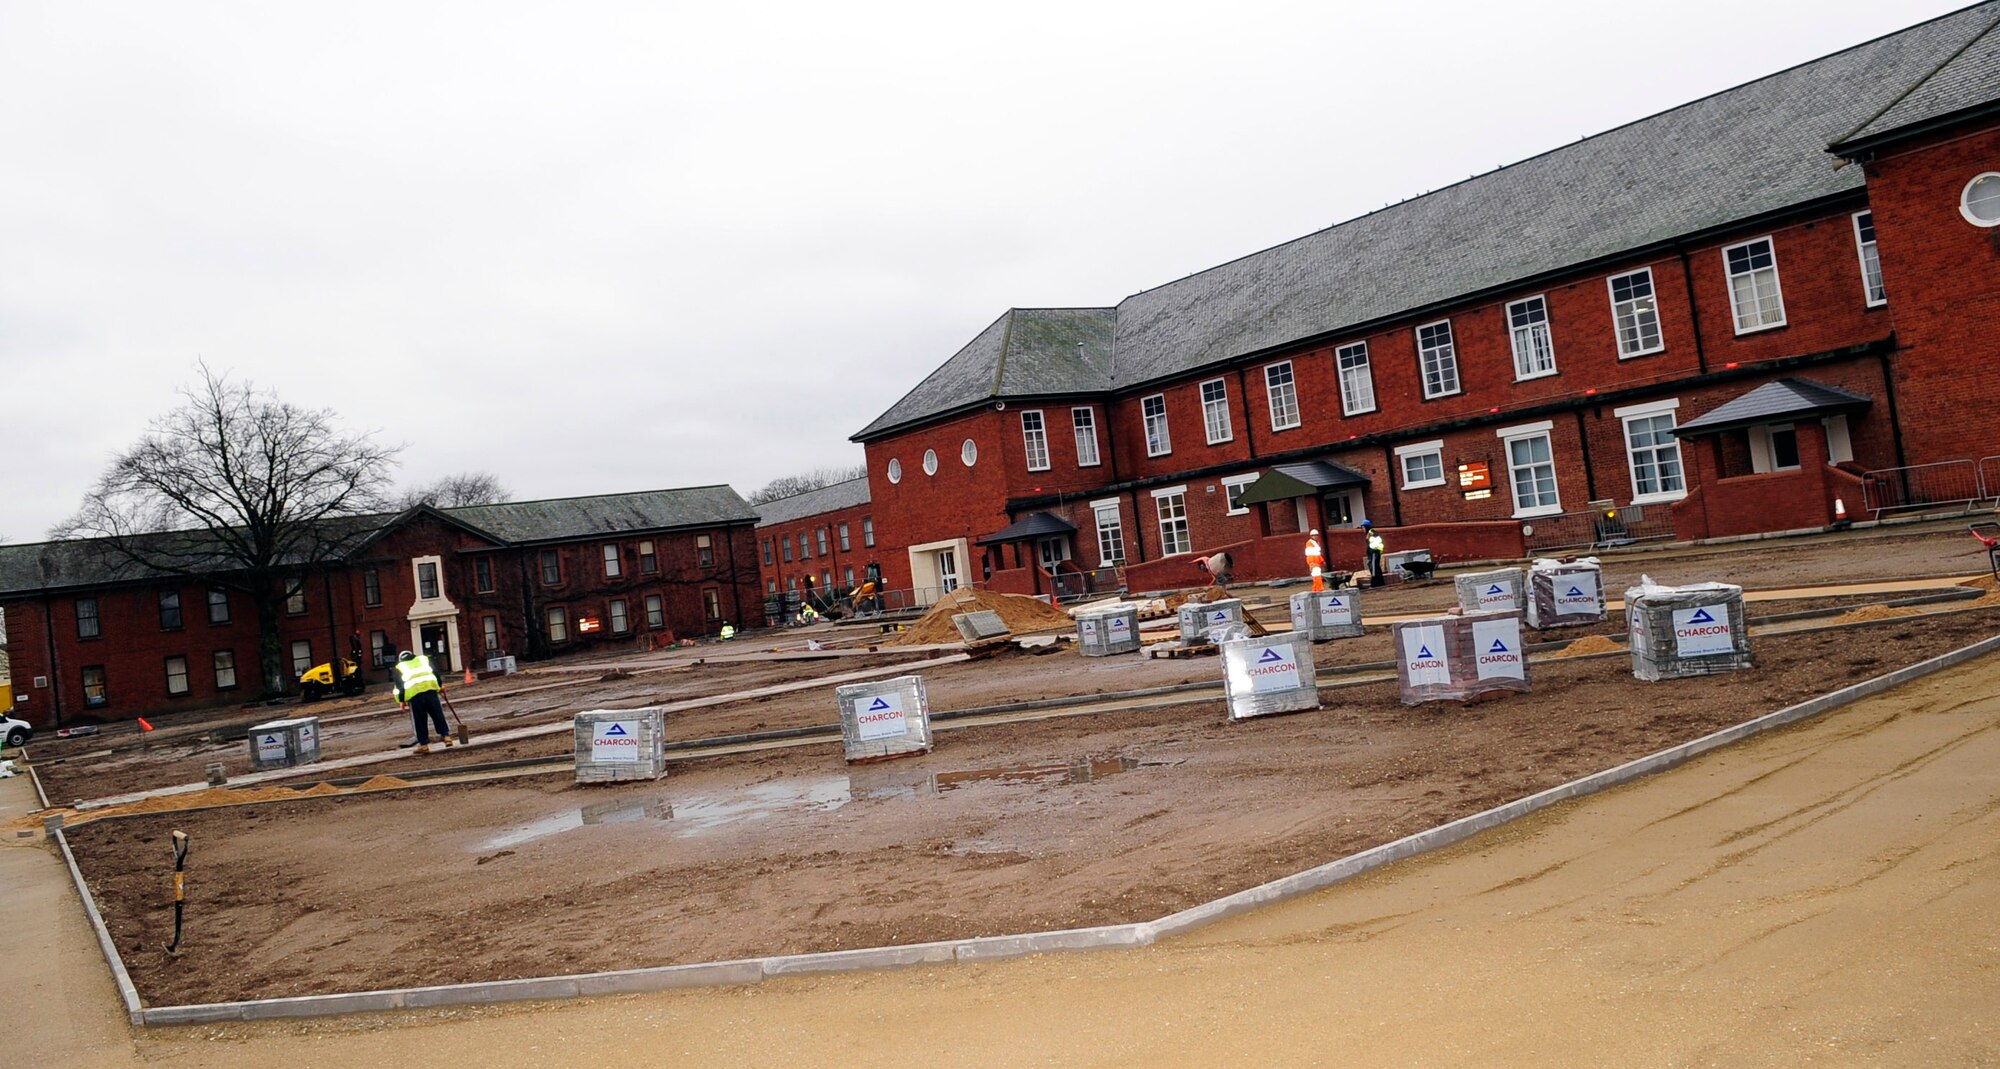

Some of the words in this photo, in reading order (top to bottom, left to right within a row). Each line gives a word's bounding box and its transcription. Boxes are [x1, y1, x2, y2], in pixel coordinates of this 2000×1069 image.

[1480, 595, 1513, 604] CHARCON
[1677, 625, 1729, 638] CHARCON
[1480, 655, 1519, 665] CHARCON
[1248, 663, 1296, 677] CHARCON
[858, 711, 903, 724] CHARCON
[594, 738, 637, 746] CHARCON
